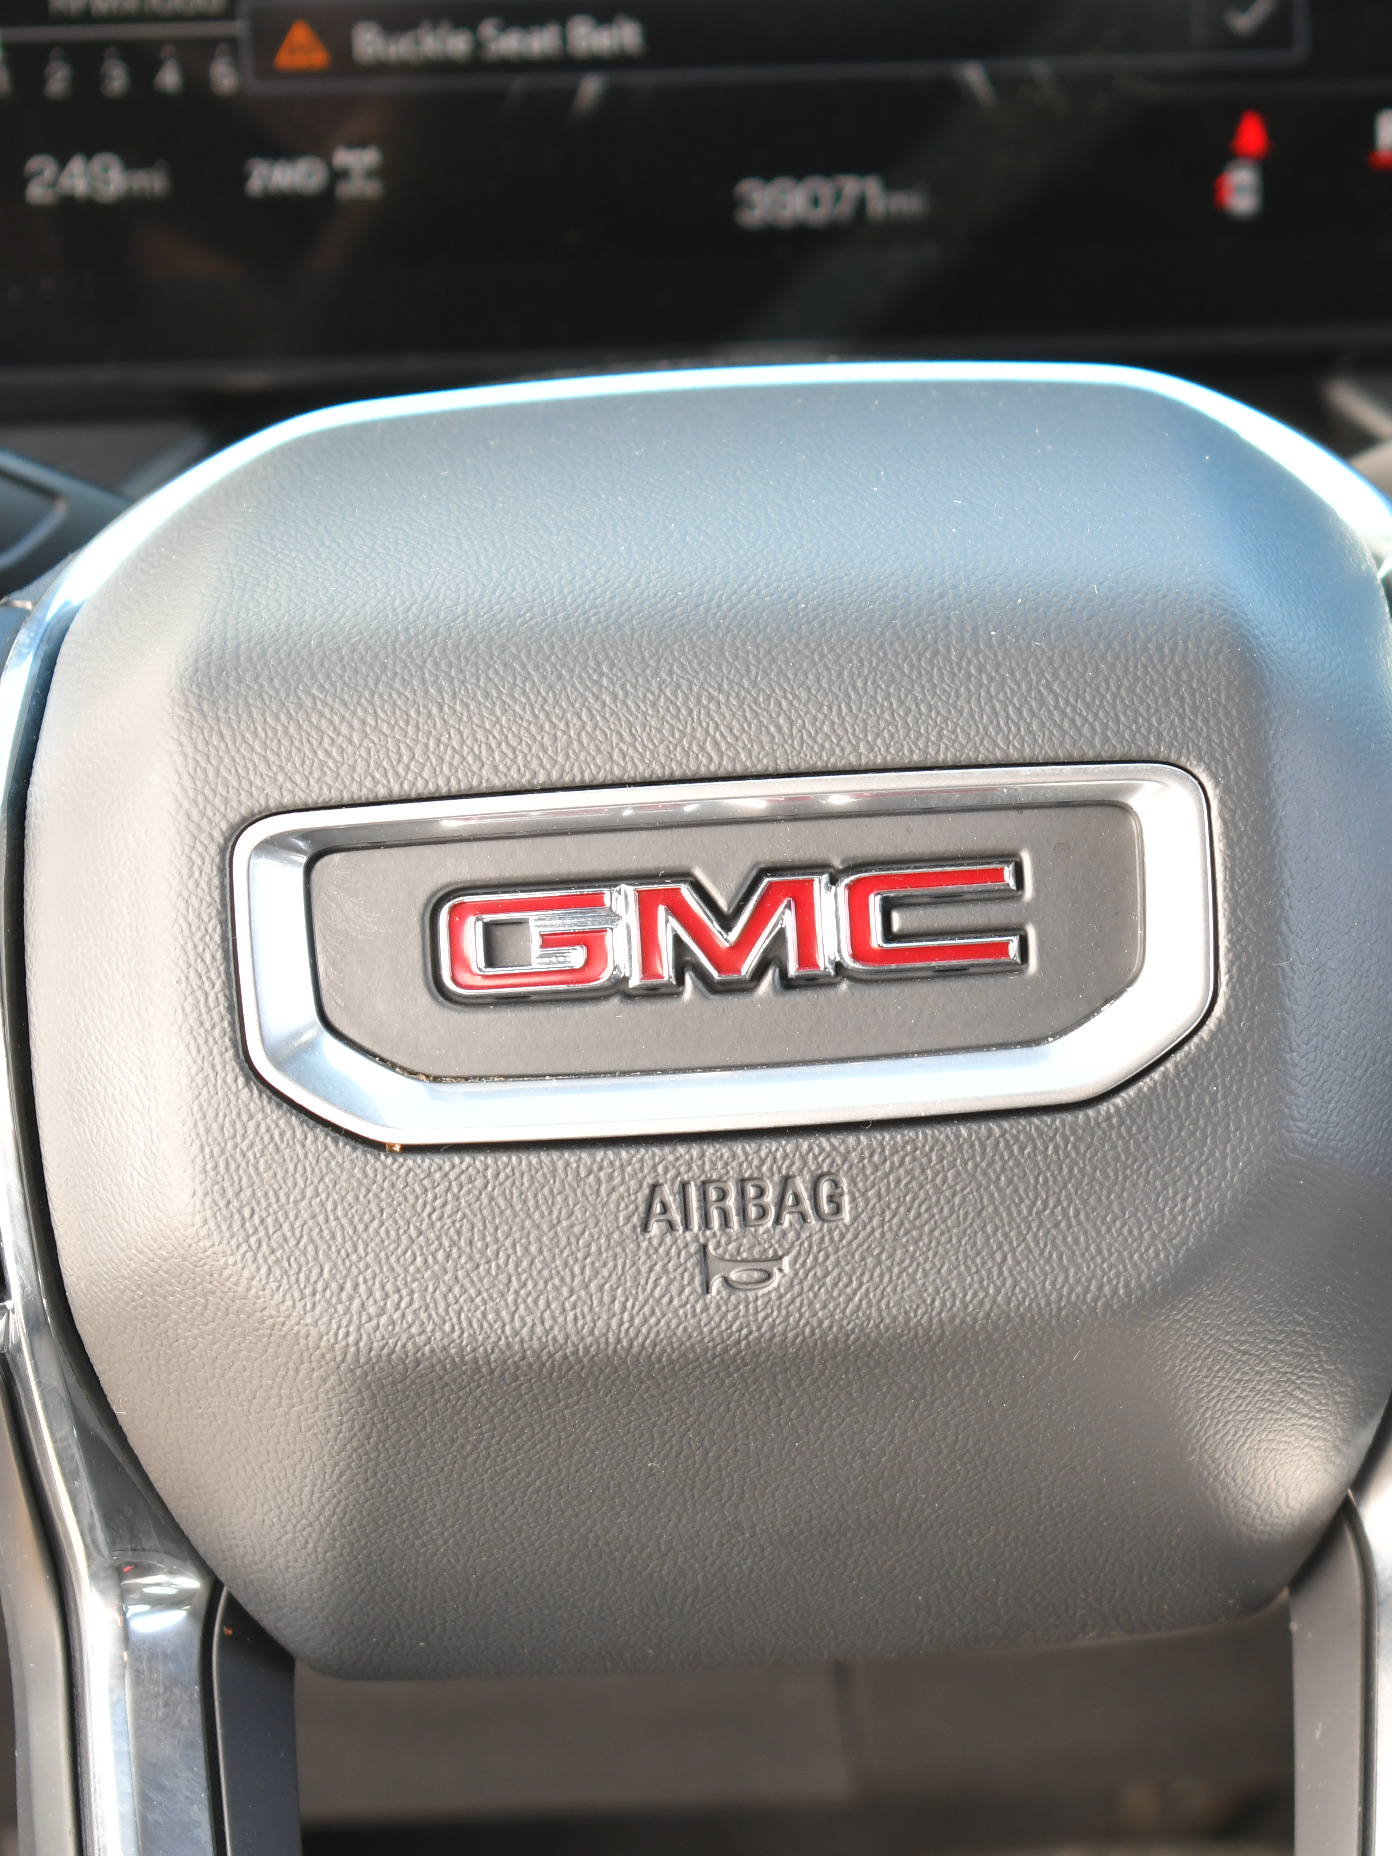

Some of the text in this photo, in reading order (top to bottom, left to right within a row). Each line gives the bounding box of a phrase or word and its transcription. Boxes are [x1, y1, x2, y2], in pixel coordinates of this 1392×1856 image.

[352, 14, 645, 64] Buckle Seat Belt
[434, 854, 1030, 1006] GMC
[640, 1171, 850, 1236] AIRBAG
